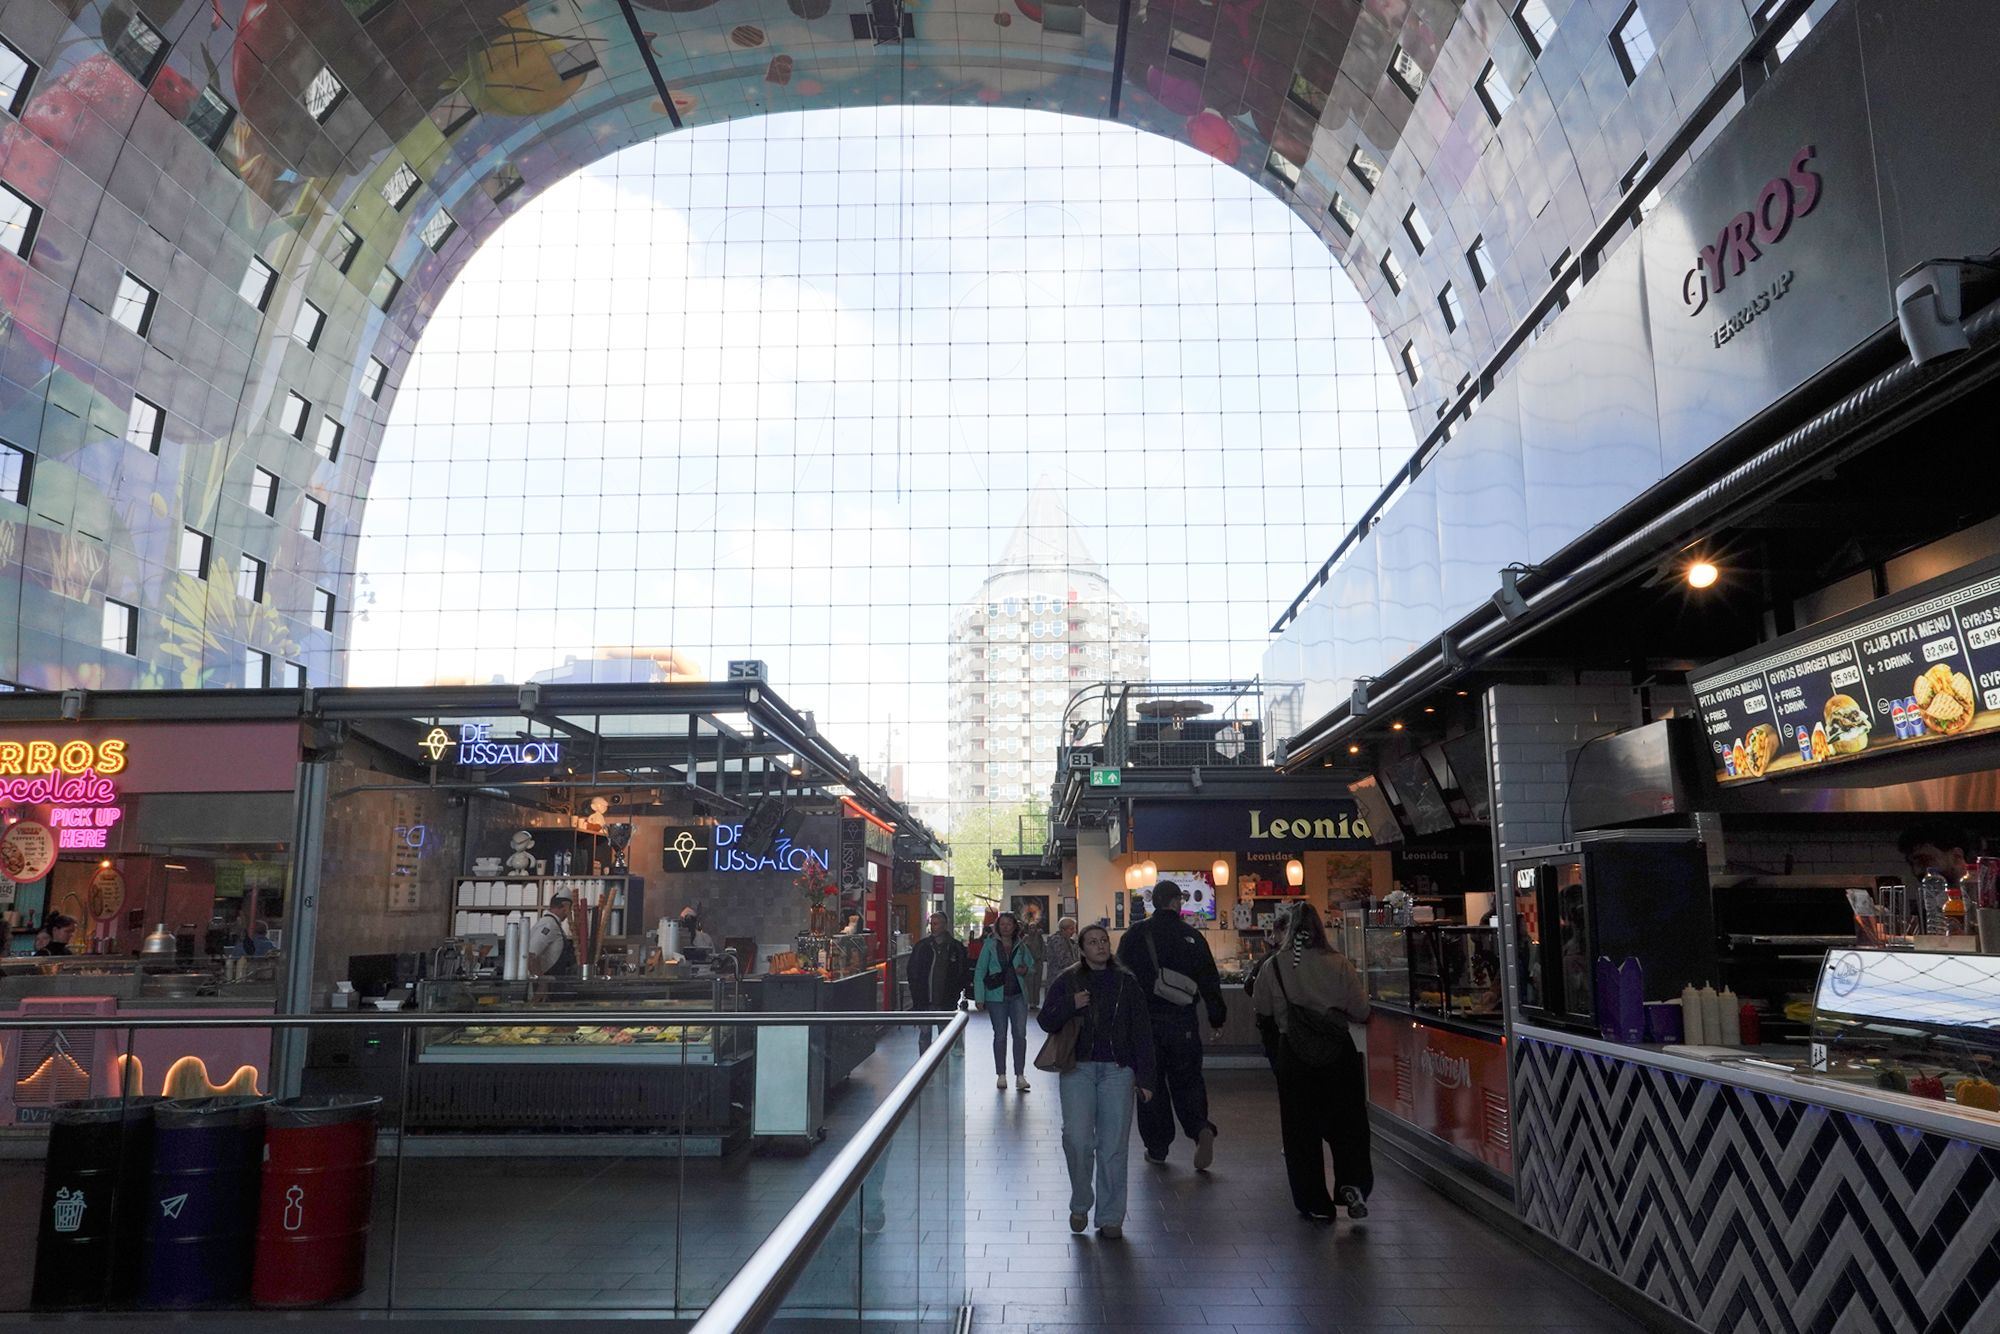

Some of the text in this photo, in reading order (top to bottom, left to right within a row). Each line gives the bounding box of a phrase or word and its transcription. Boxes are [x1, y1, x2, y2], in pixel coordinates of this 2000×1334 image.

[1683, 145, 1823, 316] GYROS
[1710, 270, 1794, 348] TERRAS UP
[1961, 609, 1993, 629] GYROS
[1863, 614, 1952, 655] CLUB PITA MENU
[1925, 641, 1956, 659] 32,99€
[1769, 647, 1852, 685] GYROS BURGER MENU
[1877, 661, 1884, 673] 2
[1883, 651, 1914, 670] DRINK
[1699, 678, 1763, 708] PITA GYROS MENU
[1780, 686, 1802, 701] FRIES
[1709, 708, 1727, 722] FRIES
[1783, 698, 1807, 714] DRINK
[462, 723, 490, 743] DE
[1712, 720, 1732, 734] DRINK
[0, 740, 126, 774] RROS
[460, 743, 559, 765] IJSSALON
[1072, 755, 1091, 766] 81
[50, 807, 121, 827] PICK UP
[59, 829, 107, 848] HERE
[1247, 851, 1294, 861] Leonidas
[1402, 851, 1449, 861] Leonidas
